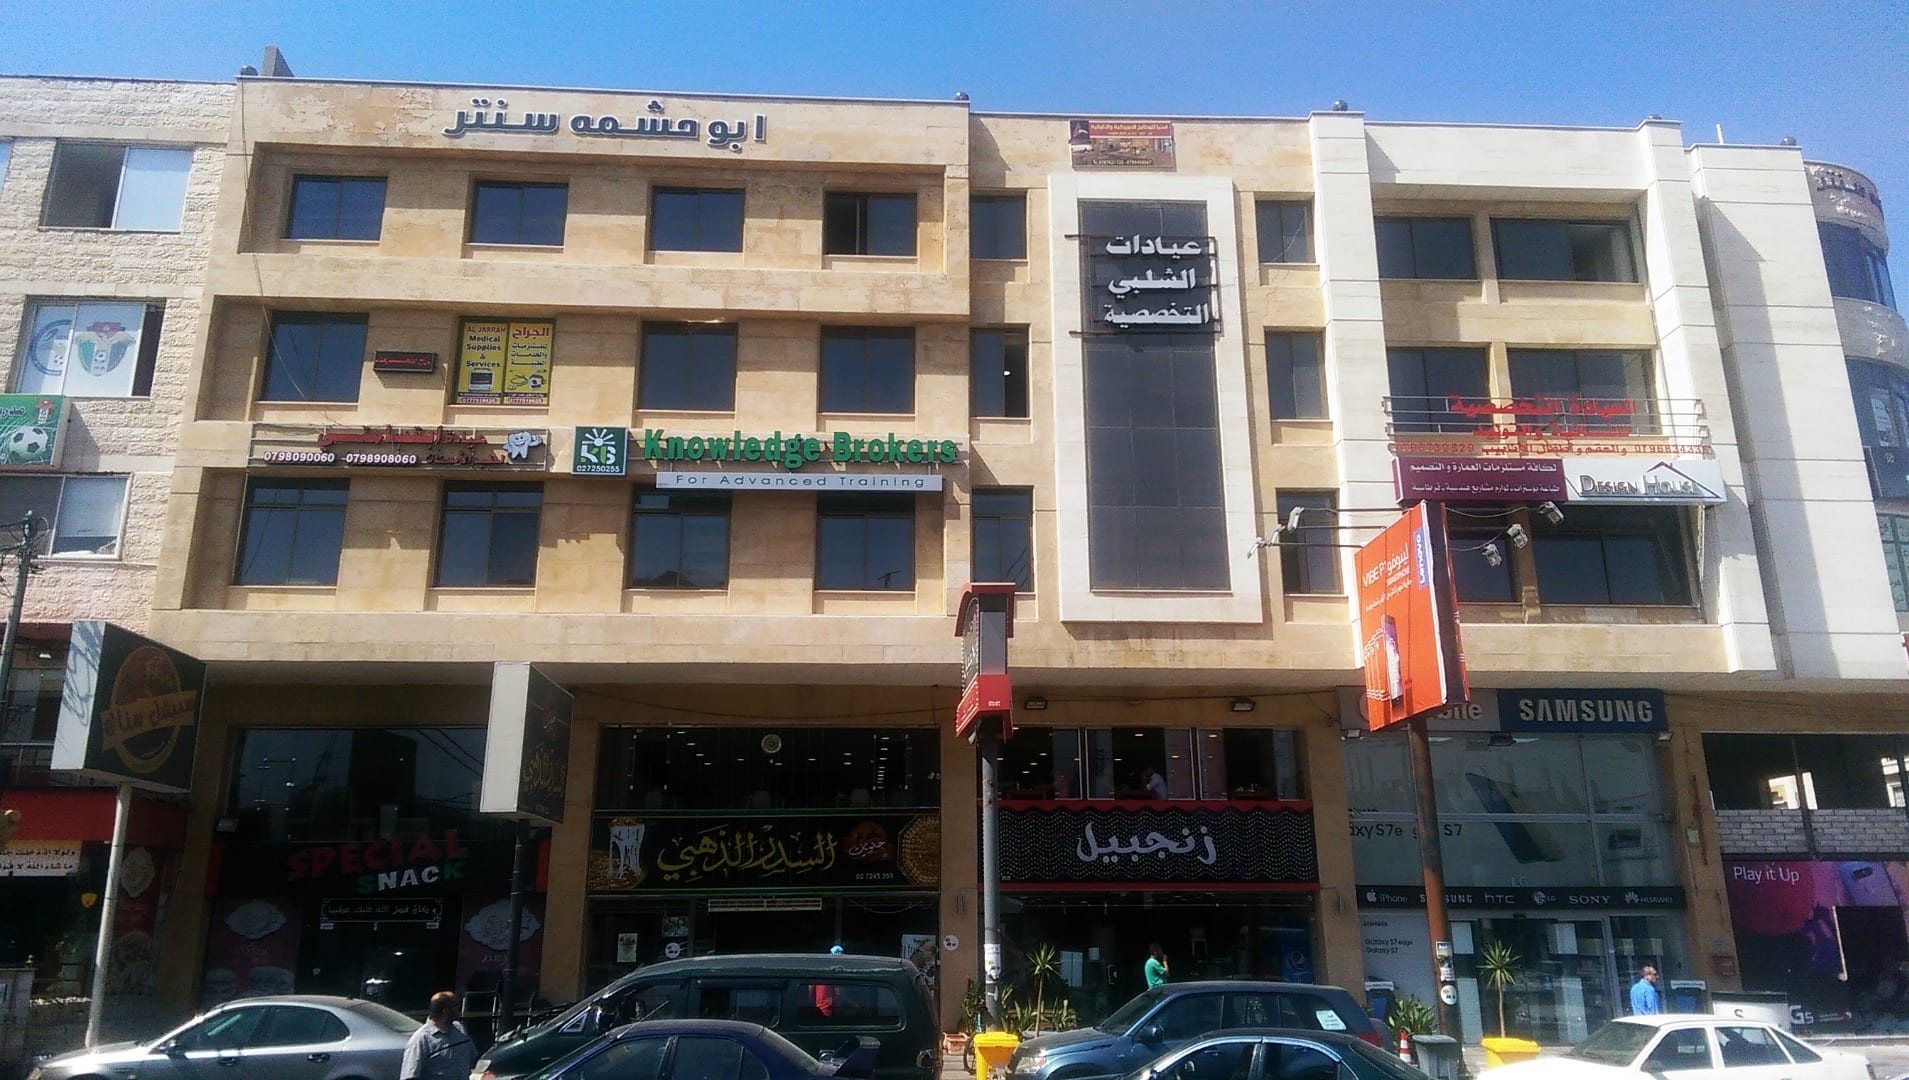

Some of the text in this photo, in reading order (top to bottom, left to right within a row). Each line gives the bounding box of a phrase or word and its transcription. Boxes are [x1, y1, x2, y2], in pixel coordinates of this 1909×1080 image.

[442, 98, 767, 152] ابو حشمه سنتر
[1105, 234, 1202, 259] عيادات
[1107, 267, 1197, 299] الشلبي
[1103, 302, 1210, 328] التخصصية
[512, 327, 549, 340] الجراح
[466, 343, 501, 352] Supplies
[466, 360, 501, 368] Services
[263, 451, 335, 463] 0798090060
[643, 428, 958, 469] Knowledge Brokers
[576, 464, 620, 473] 027250255
[1409, 463, 1444, 474] التصميم
[676, 474, 926, 488] For Advanced Training
[1579, 475, 1638, 495] DESIGN
[1362, 566, 1380, 588] VIBE
[1519, 698, 1653, 724] SAMSUNG
[656, 823, 838, 884] السدر الذهبي
[1076, 821, 1218, 865] زنجبيل
[287, 829, 468, 881] SPECIAL
[356, 862, 465, 894] SNACK
[1733, 866, 1801, 885] Play it Up
[1379, 893, 1409, 904] iPhone
[1419, 893, 1473, 904] SSUNG
[1568, 895, 1611, 905] SONY
[1640, 896, 1674, 904] HUAWEI
[1790, 1004, 1815, 1025] G5
